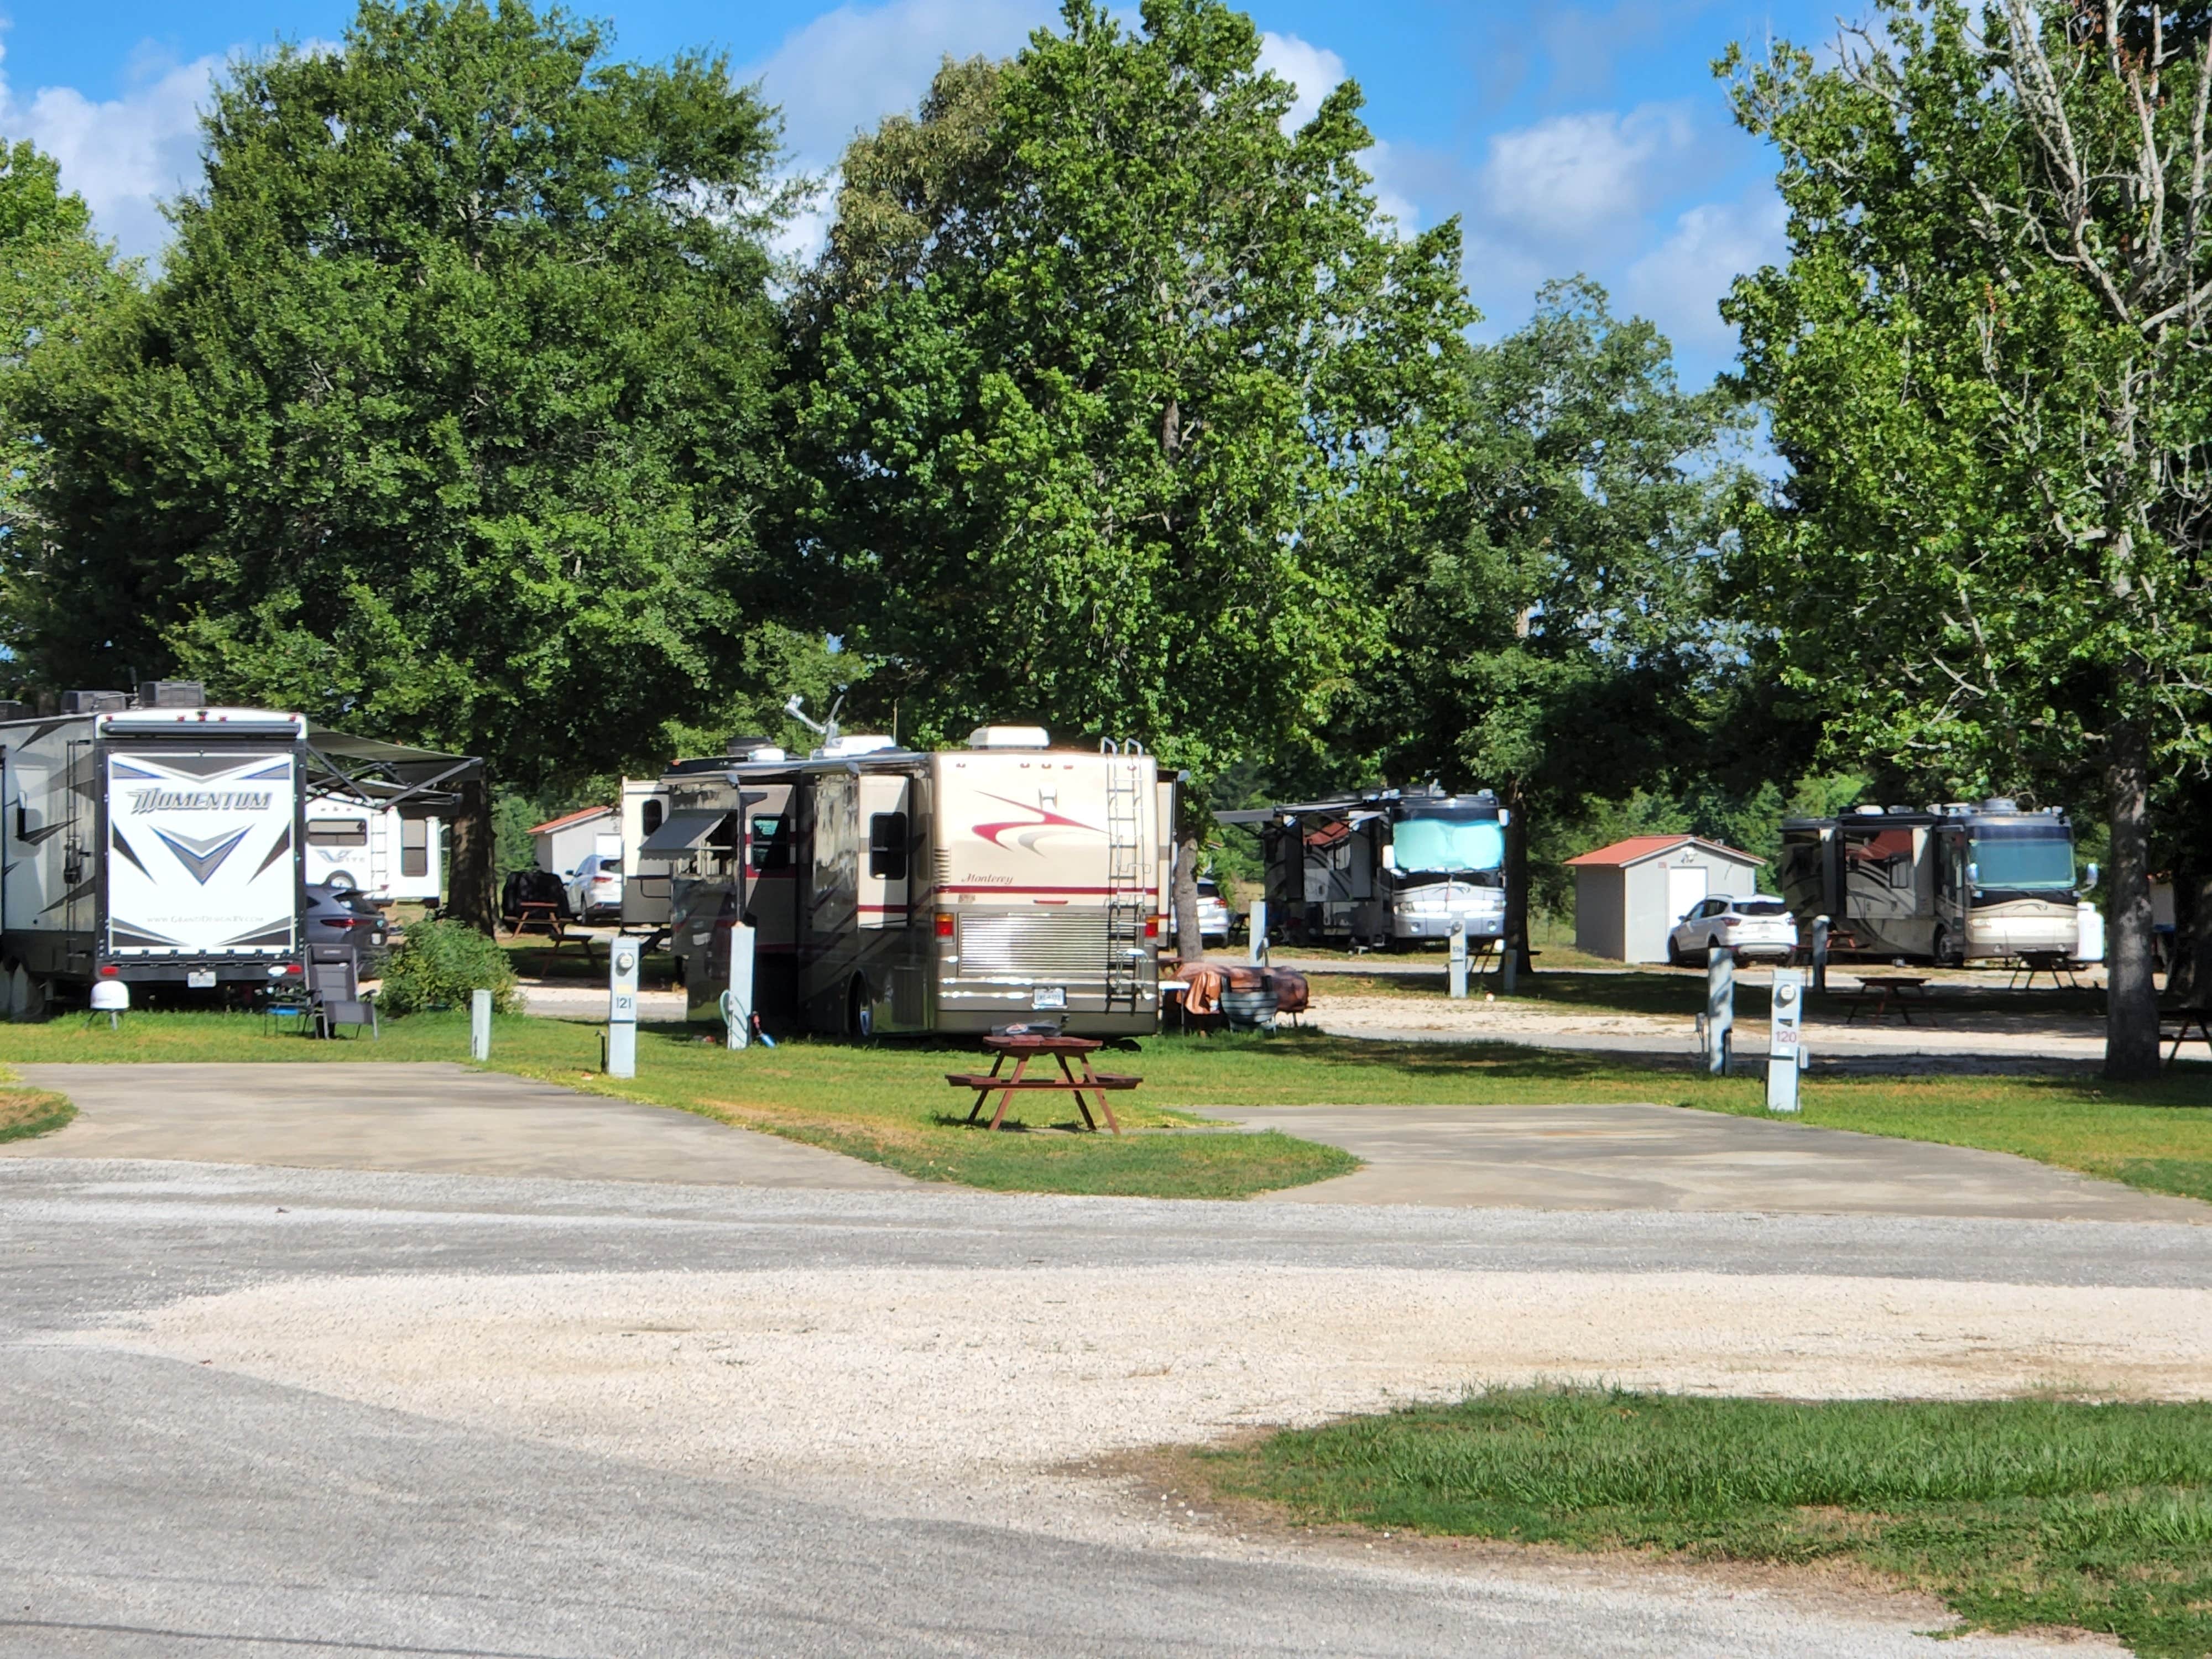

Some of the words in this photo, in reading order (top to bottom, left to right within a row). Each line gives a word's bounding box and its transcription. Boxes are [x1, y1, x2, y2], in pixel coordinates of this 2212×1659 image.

[126, 787, 273, 815] MOMENTUM
[961, 873, 1013, 884] Monterey
[617, 997, 632, 1009] 121
[1776, 1031, 1797, 1042] 120
